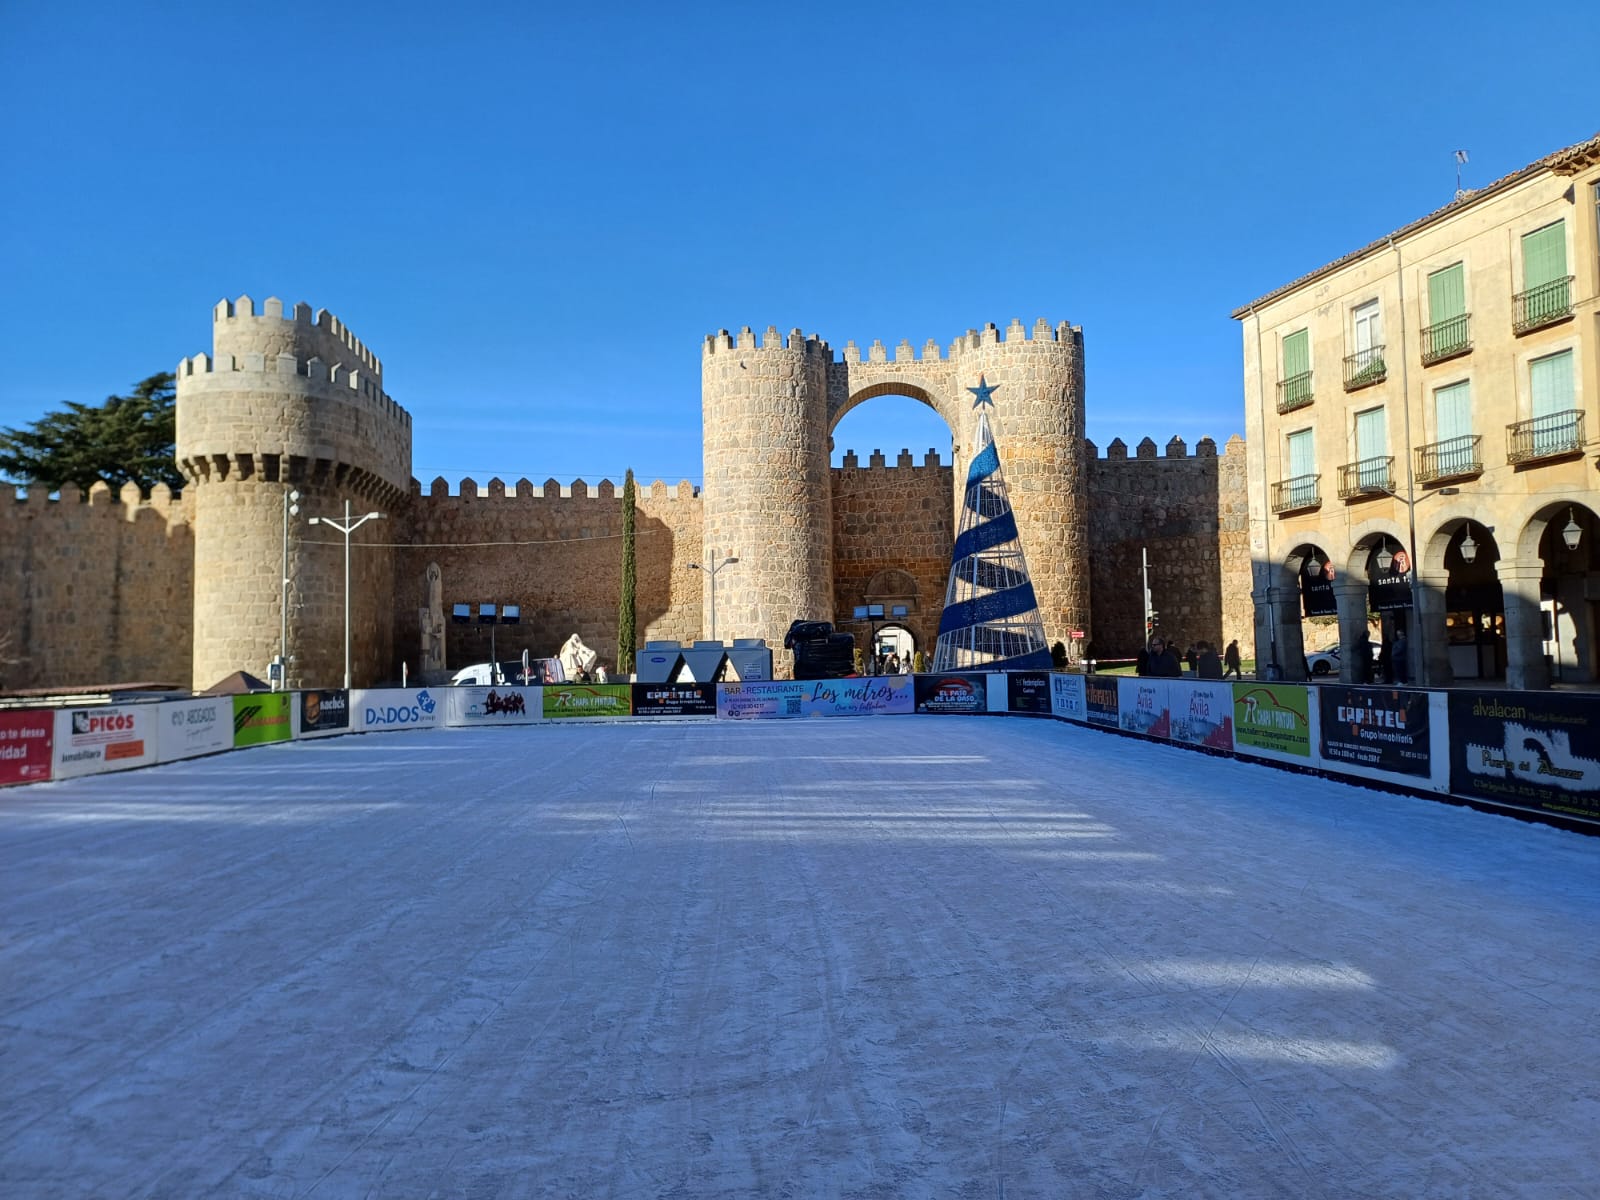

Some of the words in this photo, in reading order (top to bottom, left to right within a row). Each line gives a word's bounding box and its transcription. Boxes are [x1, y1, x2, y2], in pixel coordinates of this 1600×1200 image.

[811, 681, 839, 704] Los
[366, 706, 419, 725] DADOS
[1472, 697, 1526, 719] alvalacan
[9, 728, 18, 739] te
[1360, 728, 1377, 740] Grupo
